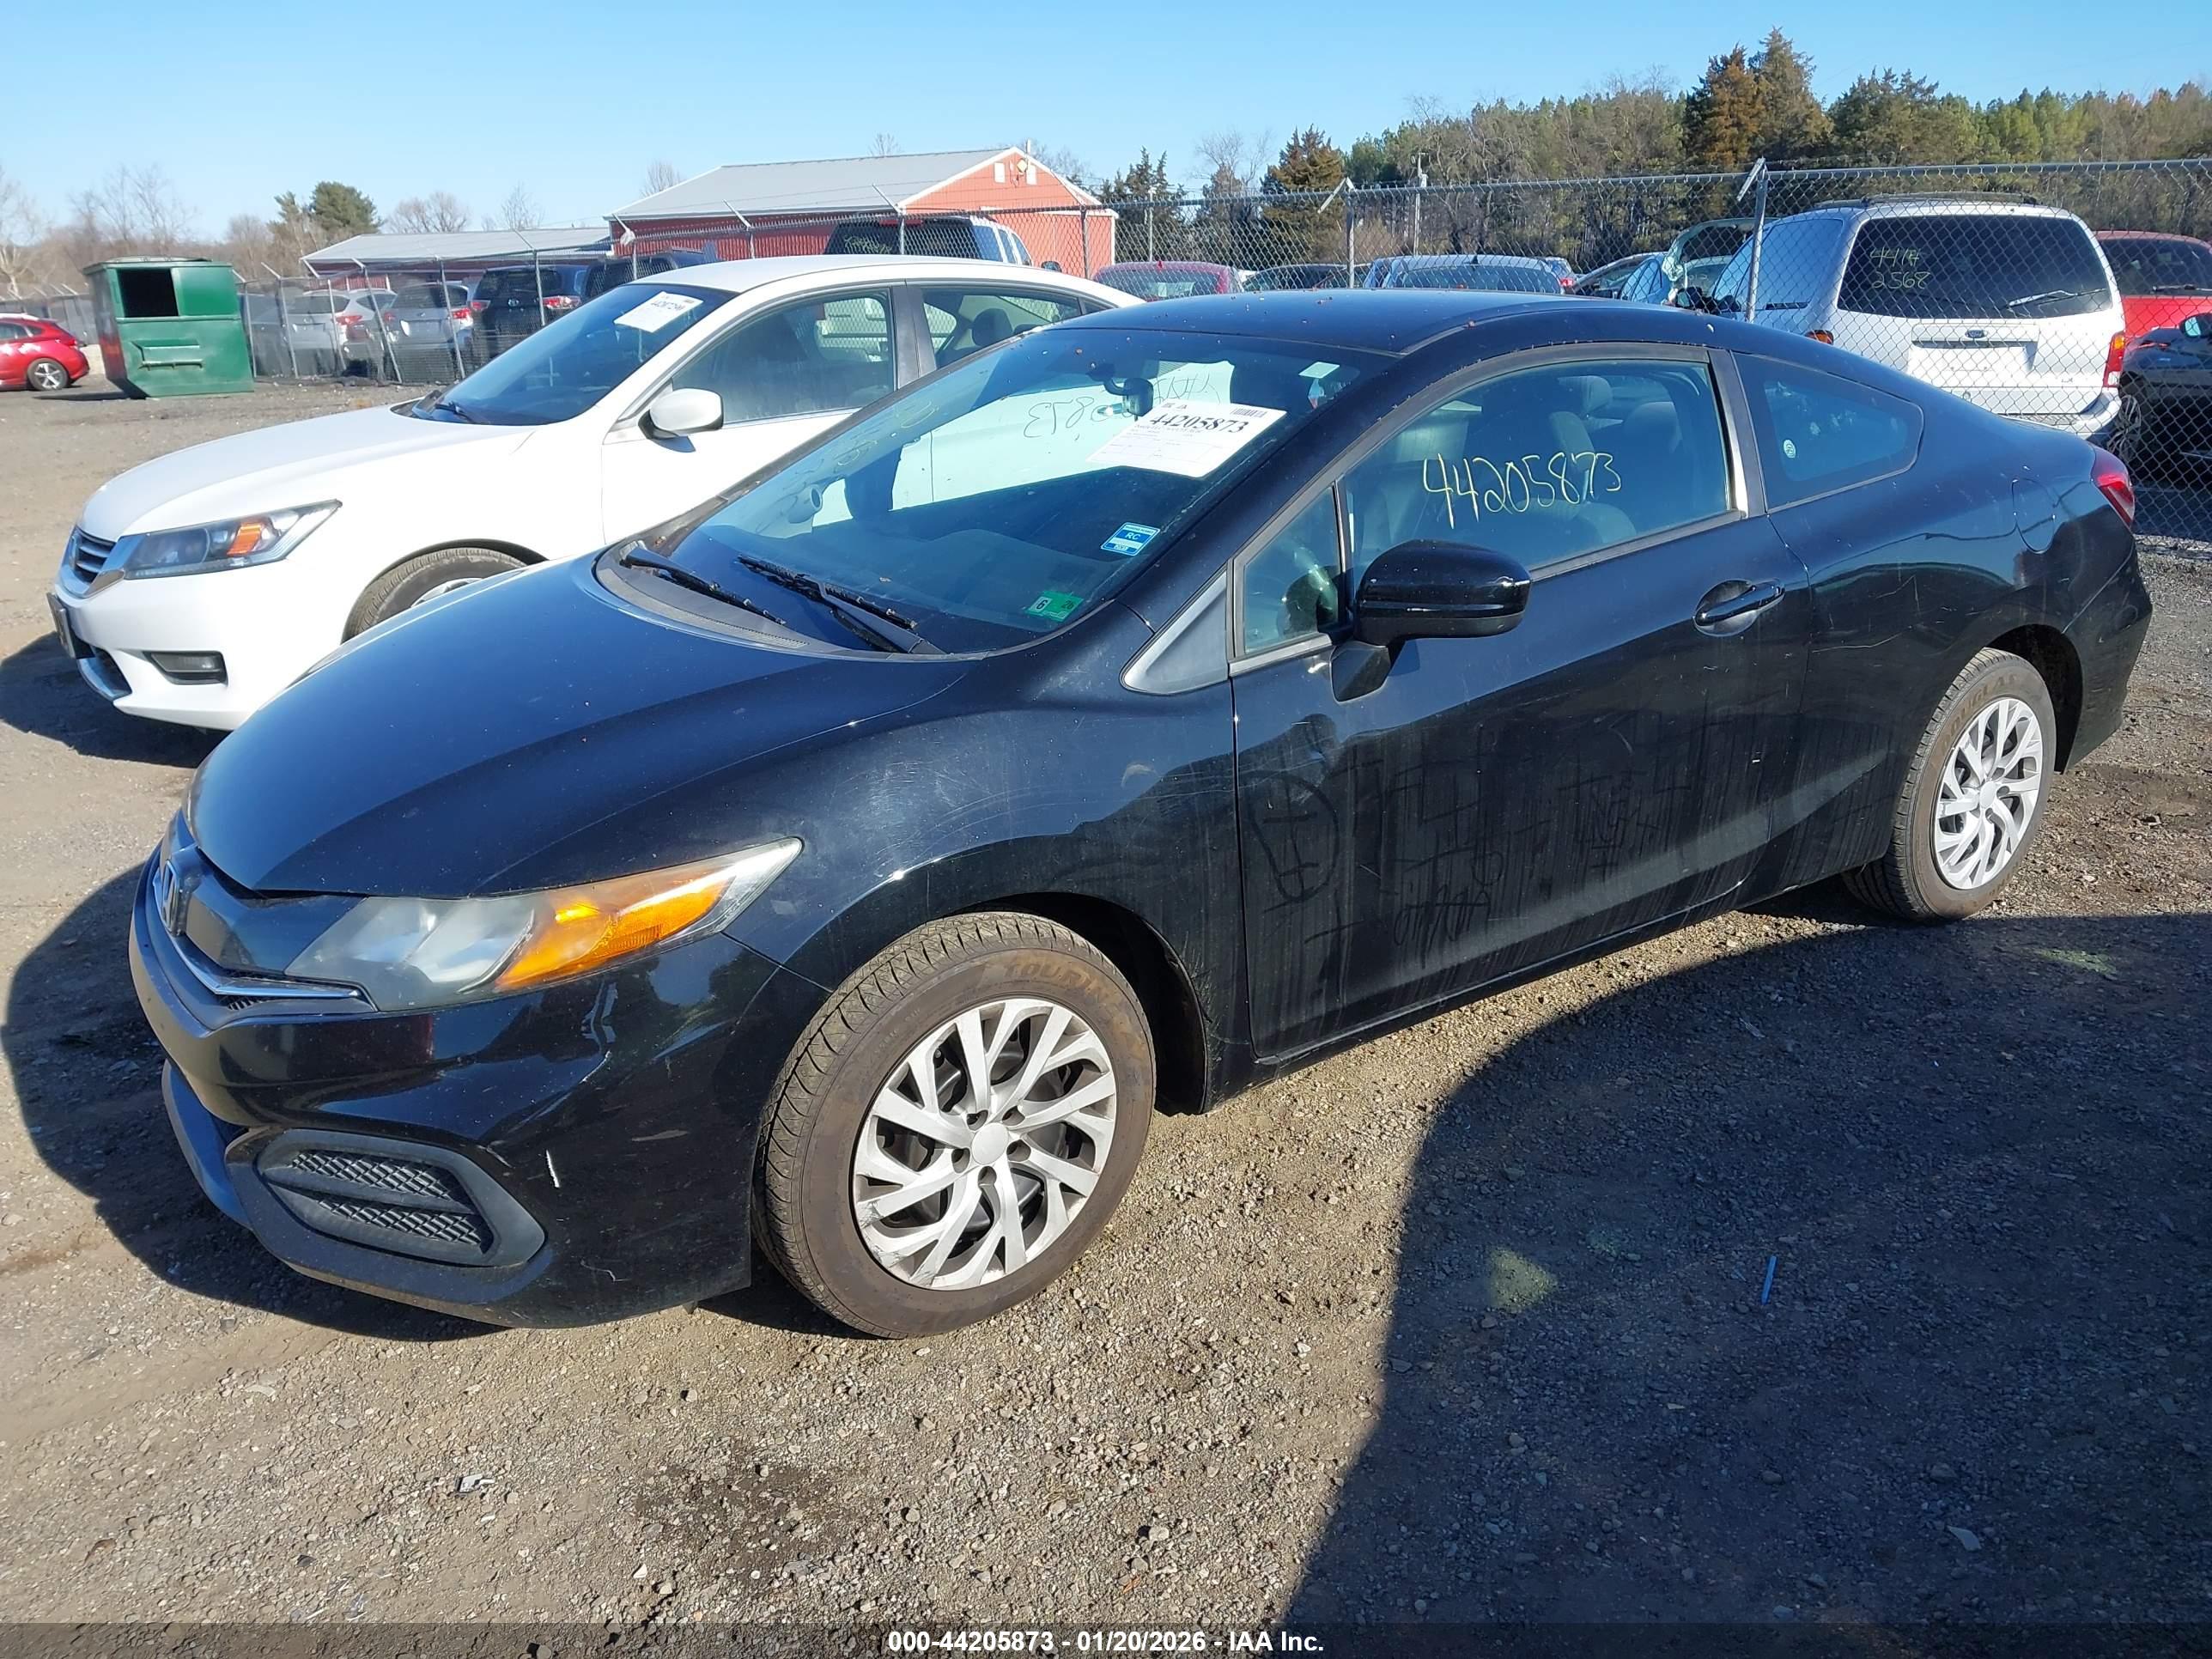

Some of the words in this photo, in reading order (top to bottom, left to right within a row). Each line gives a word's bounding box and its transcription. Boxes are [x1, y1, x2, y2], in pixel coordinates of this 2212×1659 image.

[1872, 271, 1930, 289] 2568
[1150, 414, 1249, 433] 44205873
[1423, 453, 1622, 530] 44205873
[1125, 532, 1141, 540] RC
[1036, 599, 1048, 610] 6
